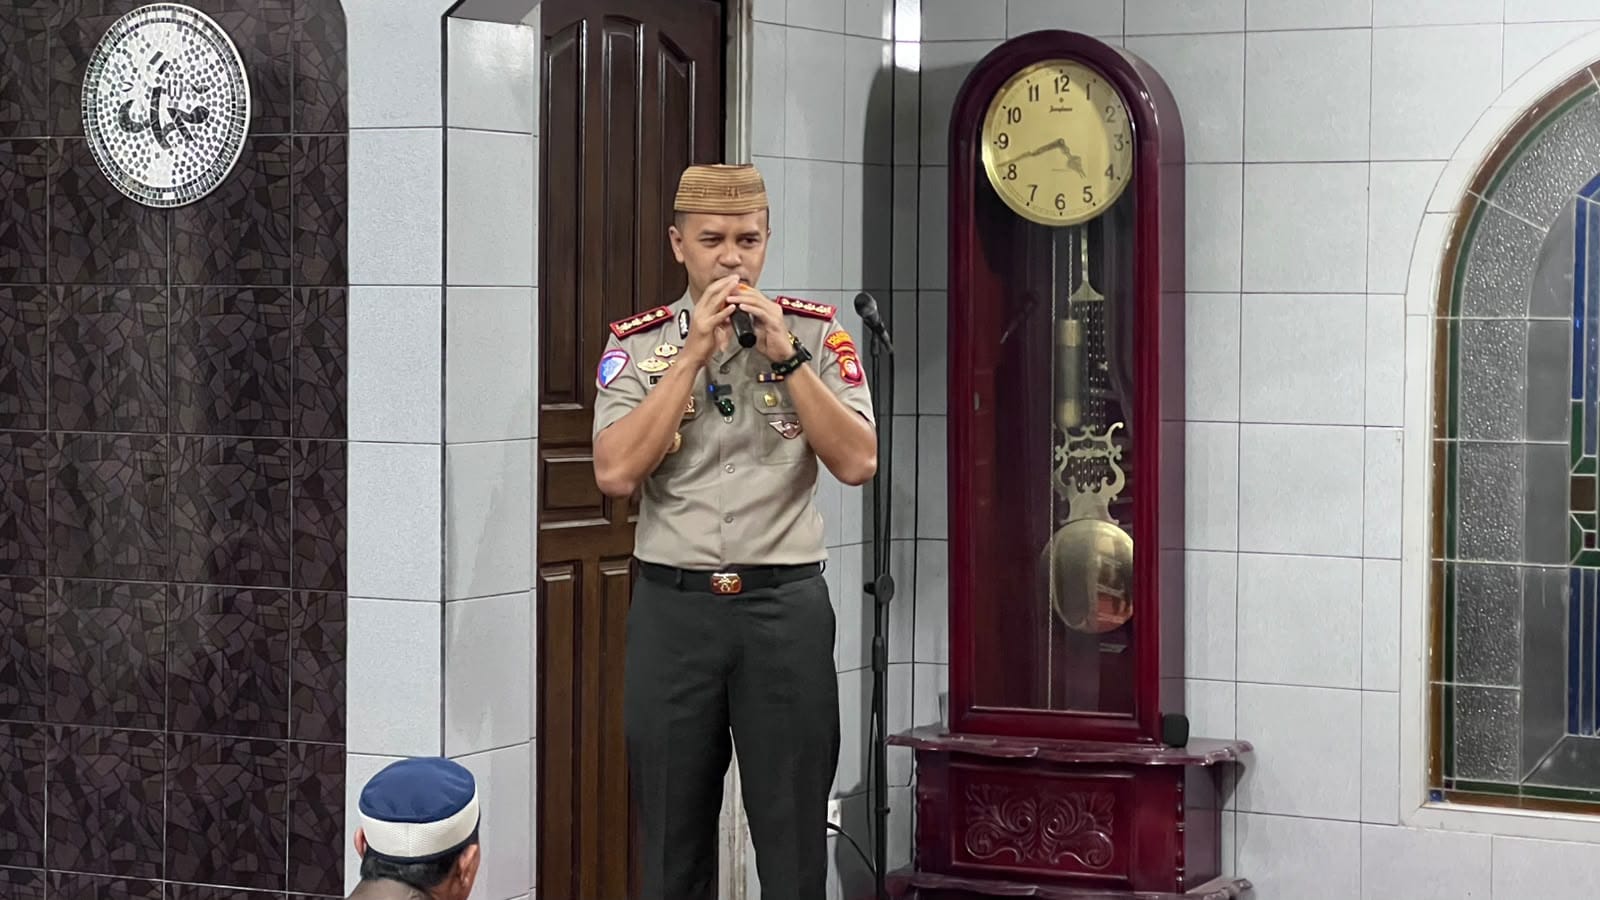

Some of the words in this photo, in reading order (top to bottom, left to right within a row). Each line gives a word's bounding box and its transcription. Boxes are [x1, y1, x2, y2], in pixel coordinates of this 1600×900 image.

[1028, 84, 1039, 102] 11
[1054, 75, 1070, 94] 12
[1085, 83, 1090, 100] 1
[1007, 107, 1021, 124] 10
[1105, 105, 1115, 123] 2
[998, 133, 1009, 149] 9
[1114, 134, 1124, 151] 3
[1007, 163, 1017, 180] 8
[1104, 163, 1114, 180] 4
[1028, 184, 1038, 201] 7
[1083, 186, 1093, 203] 5
[1055, 193, 1065, 210] 6
